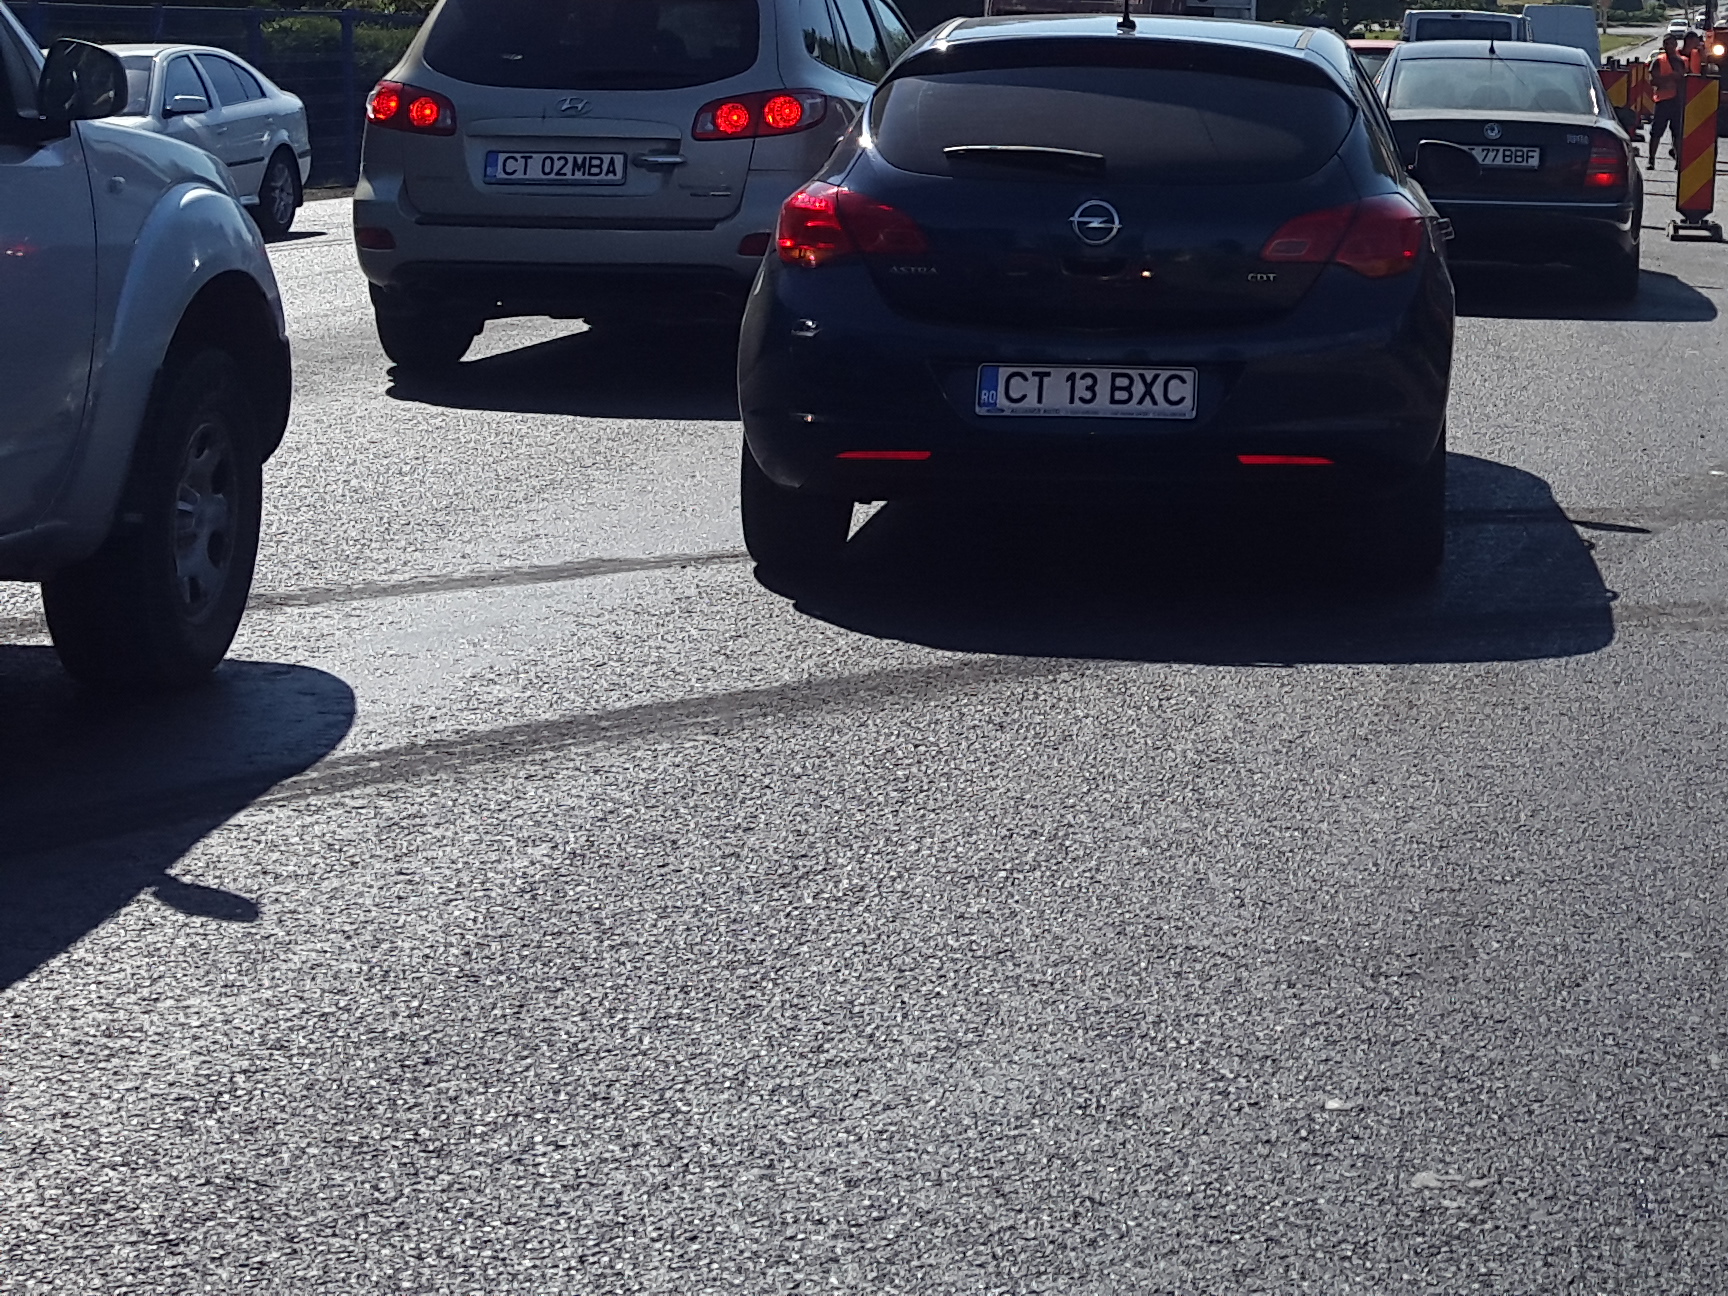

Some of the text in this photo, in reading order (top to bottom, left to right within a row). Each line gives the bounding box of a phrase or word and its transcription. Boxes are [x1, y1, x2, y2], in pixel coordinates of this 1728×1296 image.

[502, 155, 533, 176] CT
[1004, 371, 1188, 407] CT 13 BXC
